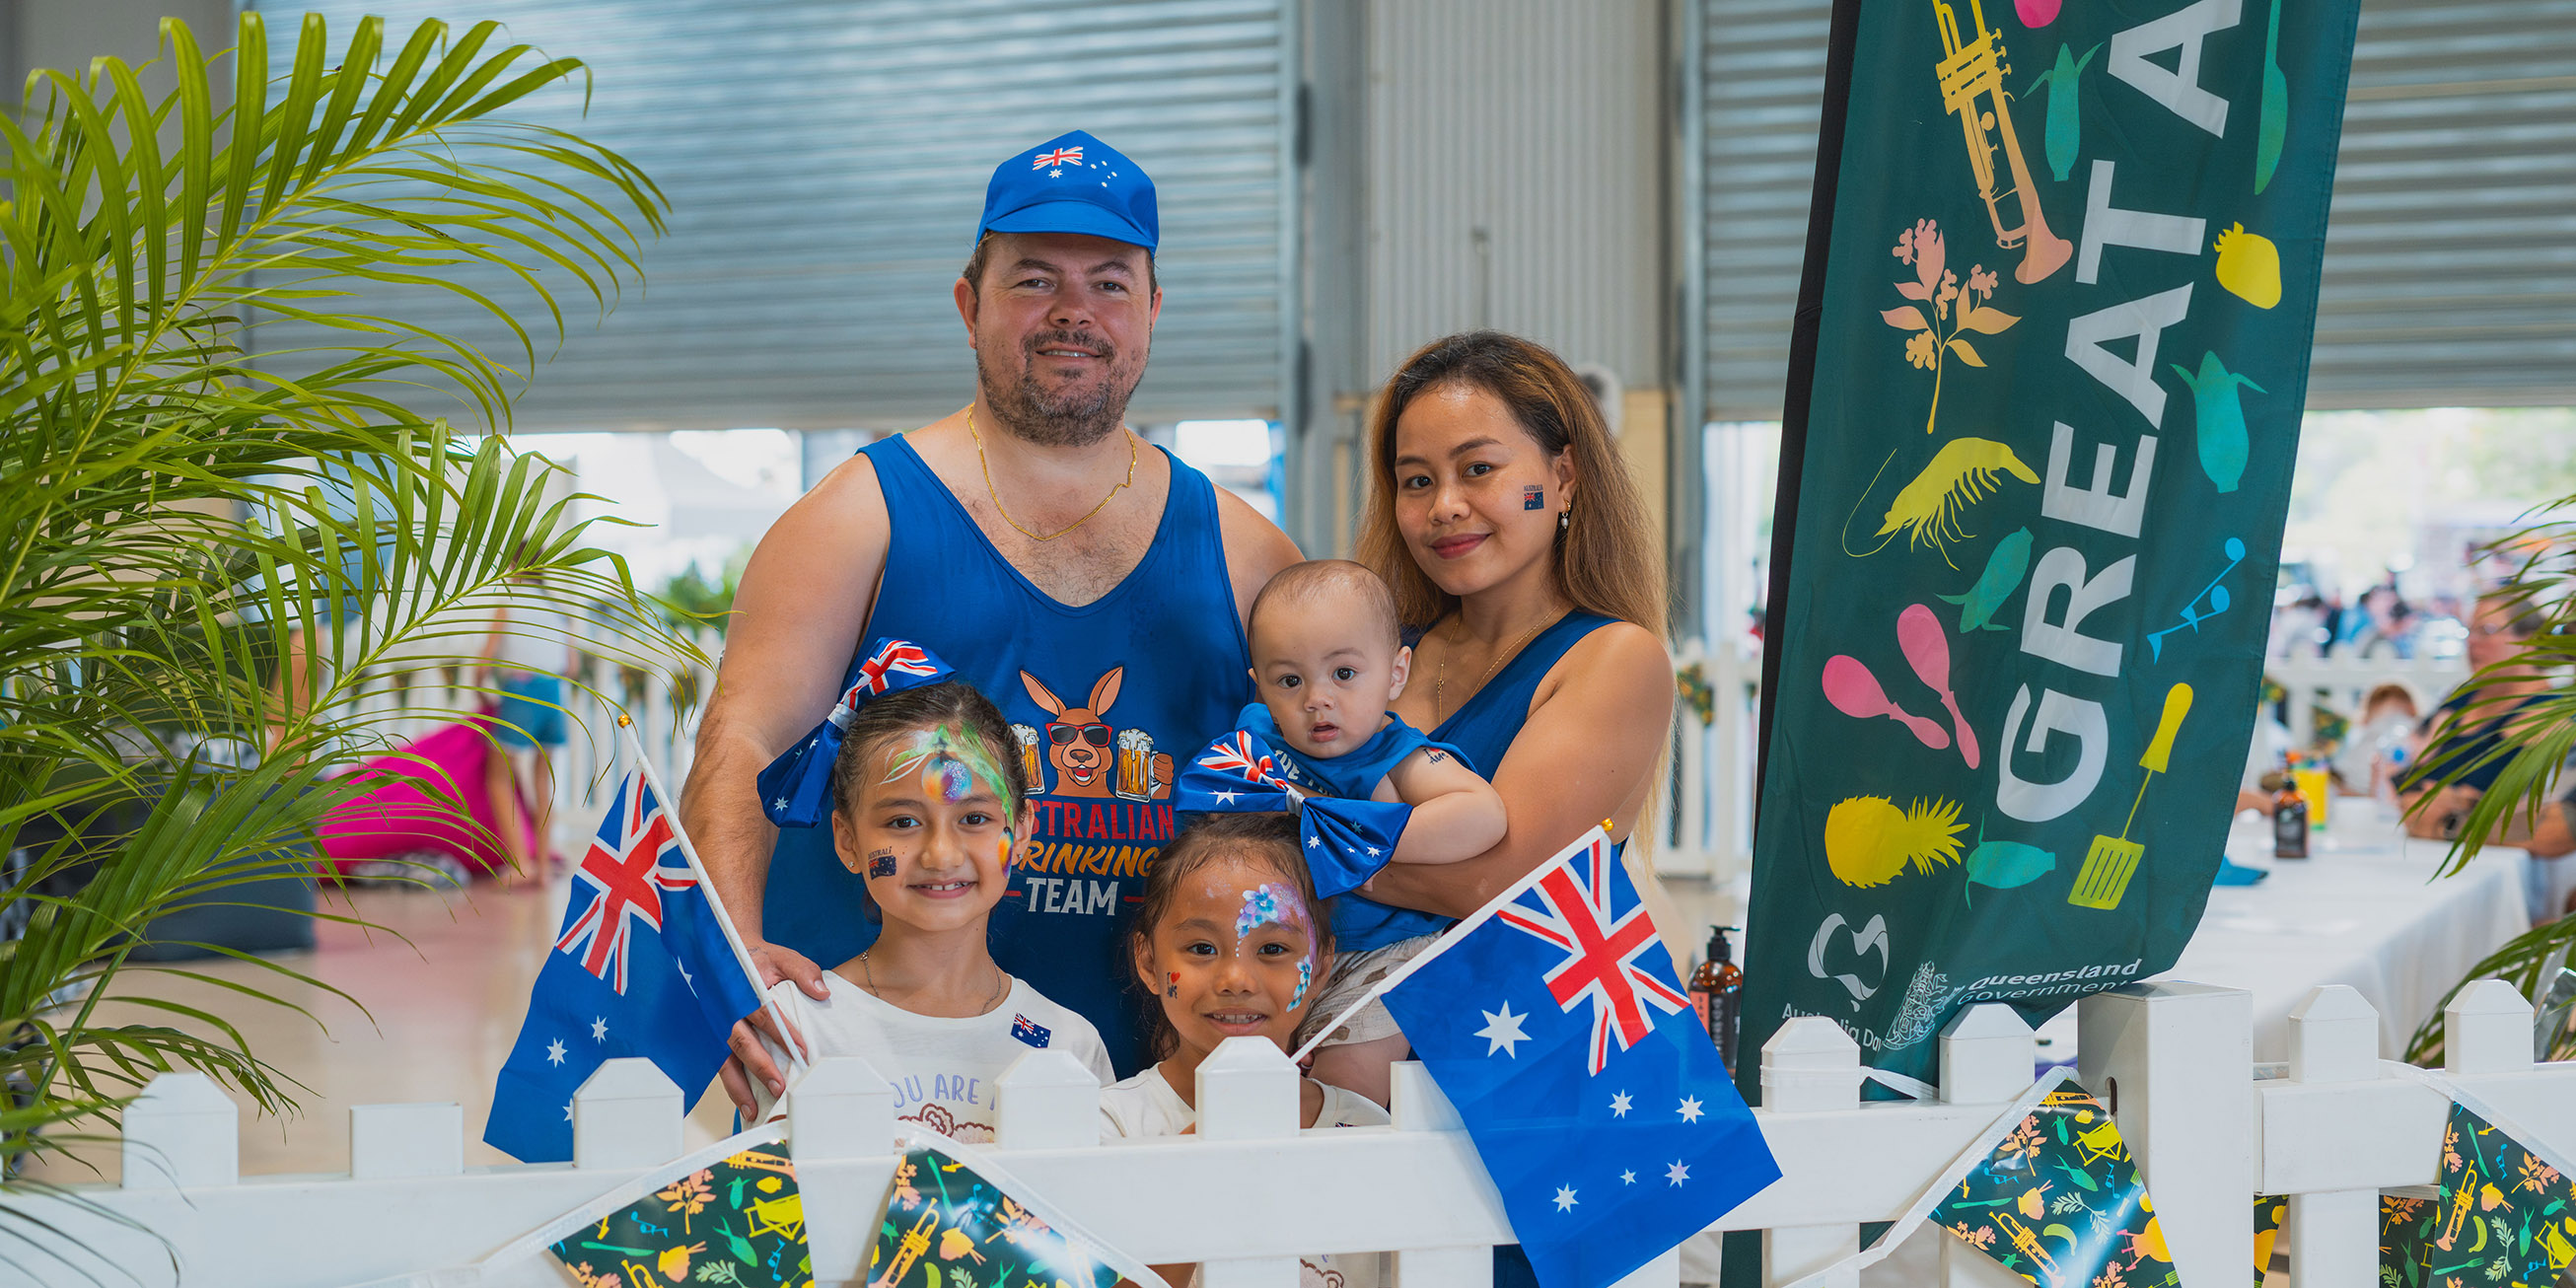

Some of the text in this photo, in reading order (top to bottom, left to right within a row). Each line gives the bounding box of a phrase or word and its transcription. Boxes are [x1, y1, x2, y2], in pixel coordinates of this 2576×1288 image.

[1995, 159, 2207, 823] GREAT
[1018, 840, 1160, 878] RINKING
[1026, 877, 1119, 916] TEAM
[1968, 958, 2142, 991] Queensland
[934, 1073, 980, 1105] ARE
